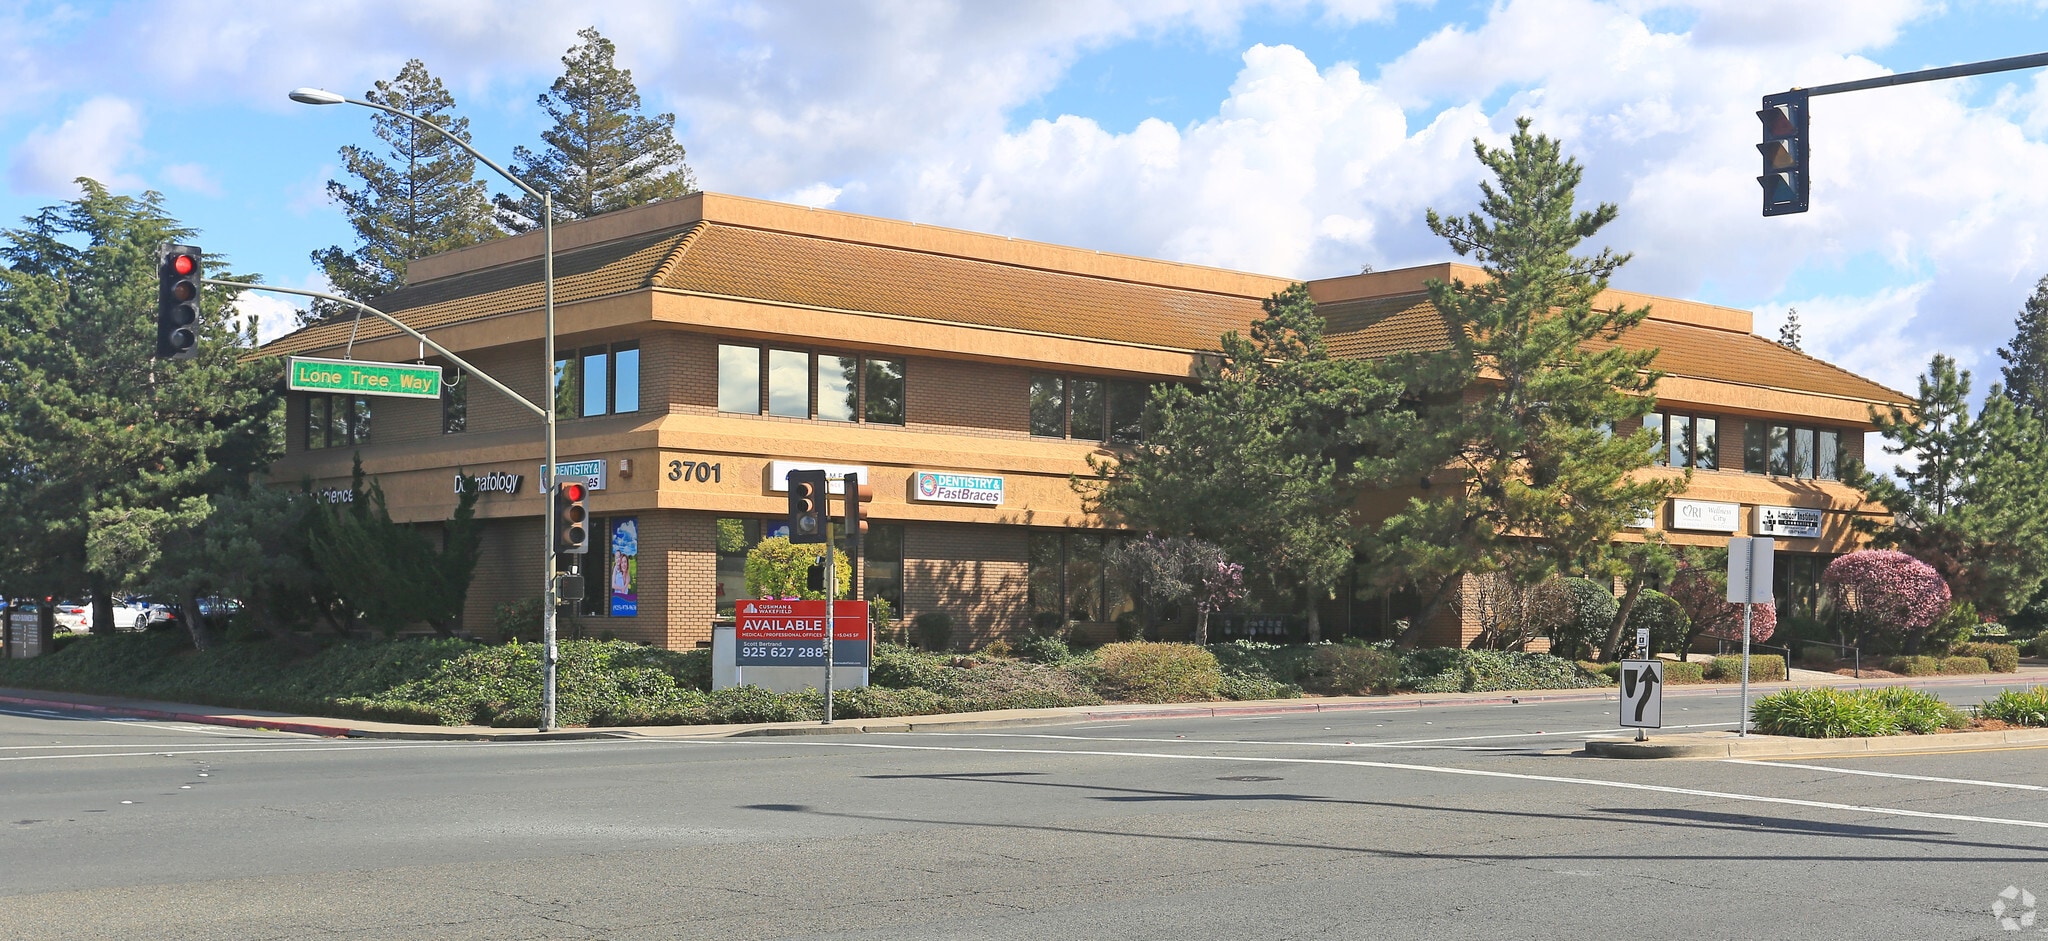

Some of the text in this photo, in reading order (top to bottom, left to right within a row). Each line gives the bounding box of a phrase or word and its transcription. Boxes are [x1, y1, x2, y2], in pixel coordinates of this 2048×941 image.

[300, 367, 433, 392] Lone Tree Way
[668, 460, 721, 483] 3701
[454, 471, 519, 494] Dematology
[938, 475, 993, 489] DENTISTRY
[937, 487, 999, 502] FastBraces
[742, 620, 823, 631] AVAILABLE
[742, 647, 826, 658] 925 627 288
